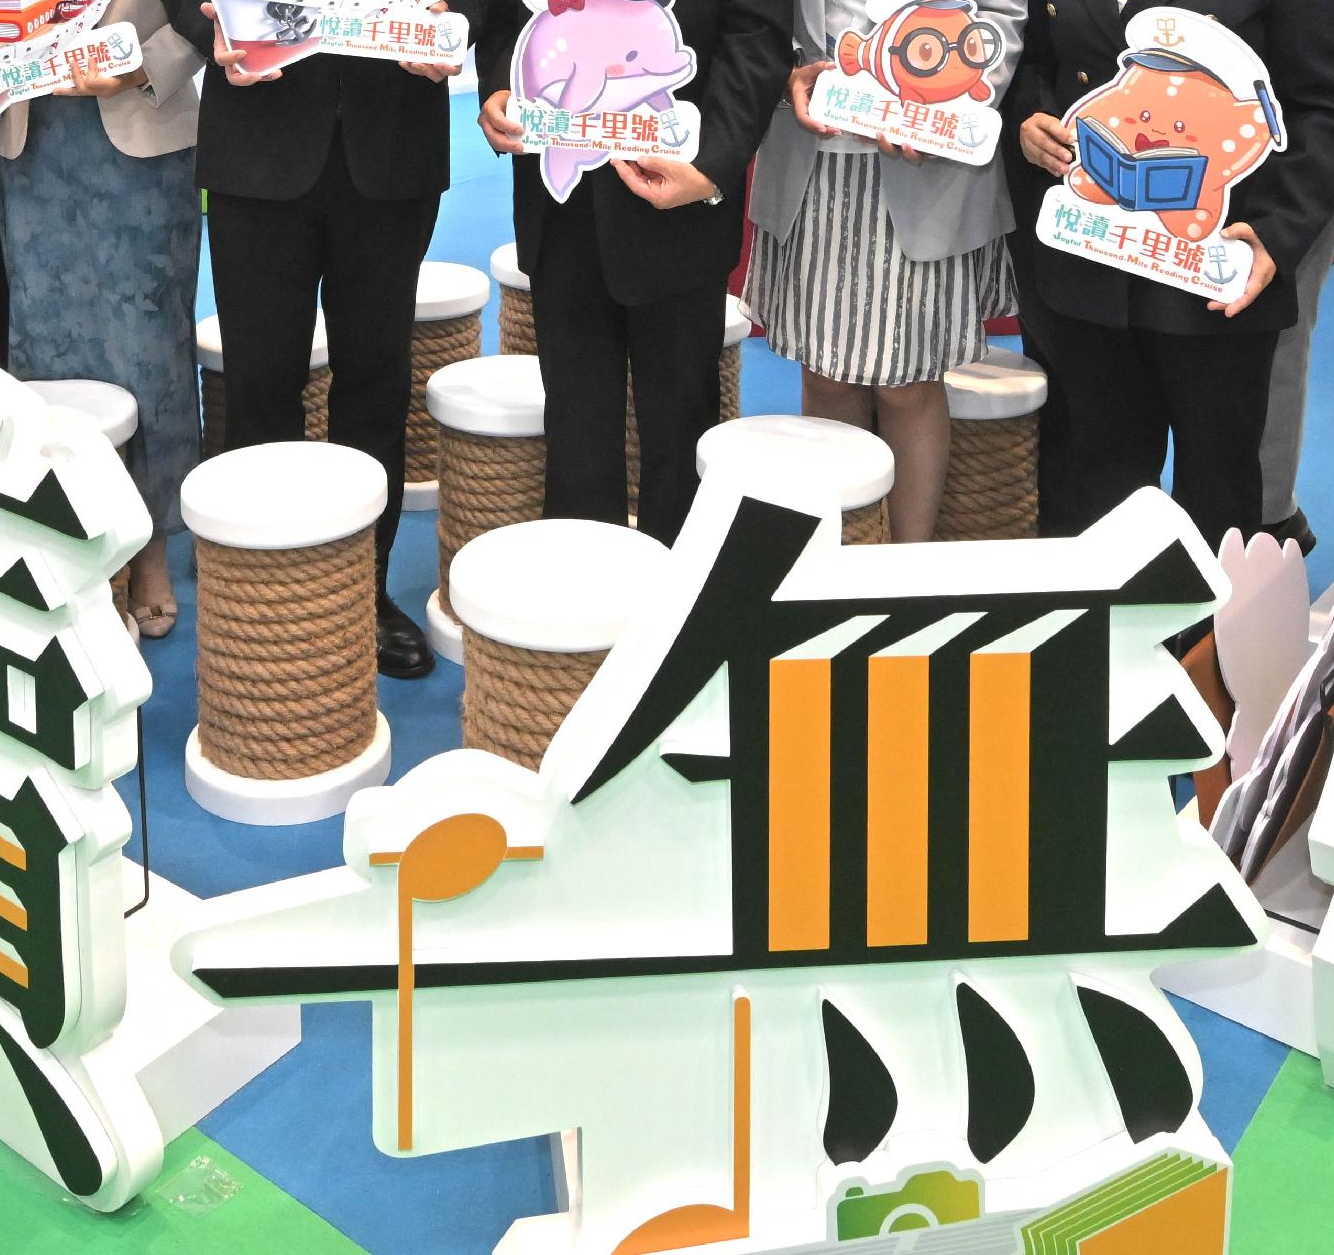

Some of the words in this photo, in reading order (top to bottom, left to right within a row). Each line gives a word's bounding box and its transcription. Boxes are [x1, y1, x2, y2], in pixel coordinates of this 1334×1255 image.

[398, 45, 428, 57] Reading
[429, 49, 454, 59] Cruise
[522, 134, 549, 146] Joyful
[614, 142, 650, 155] Reading
[651, 144, 681, 156] Cruise
[823, 109, 849, 123] Joyful
[910, 131, 945, 150] Reading
[946, 141, 976, 156] Cruise
[1053, 231, 1082, 248] Joyful
[1150, 261, 1189, 284] Reading
[1190, 274, 1224, 293] Cruise
